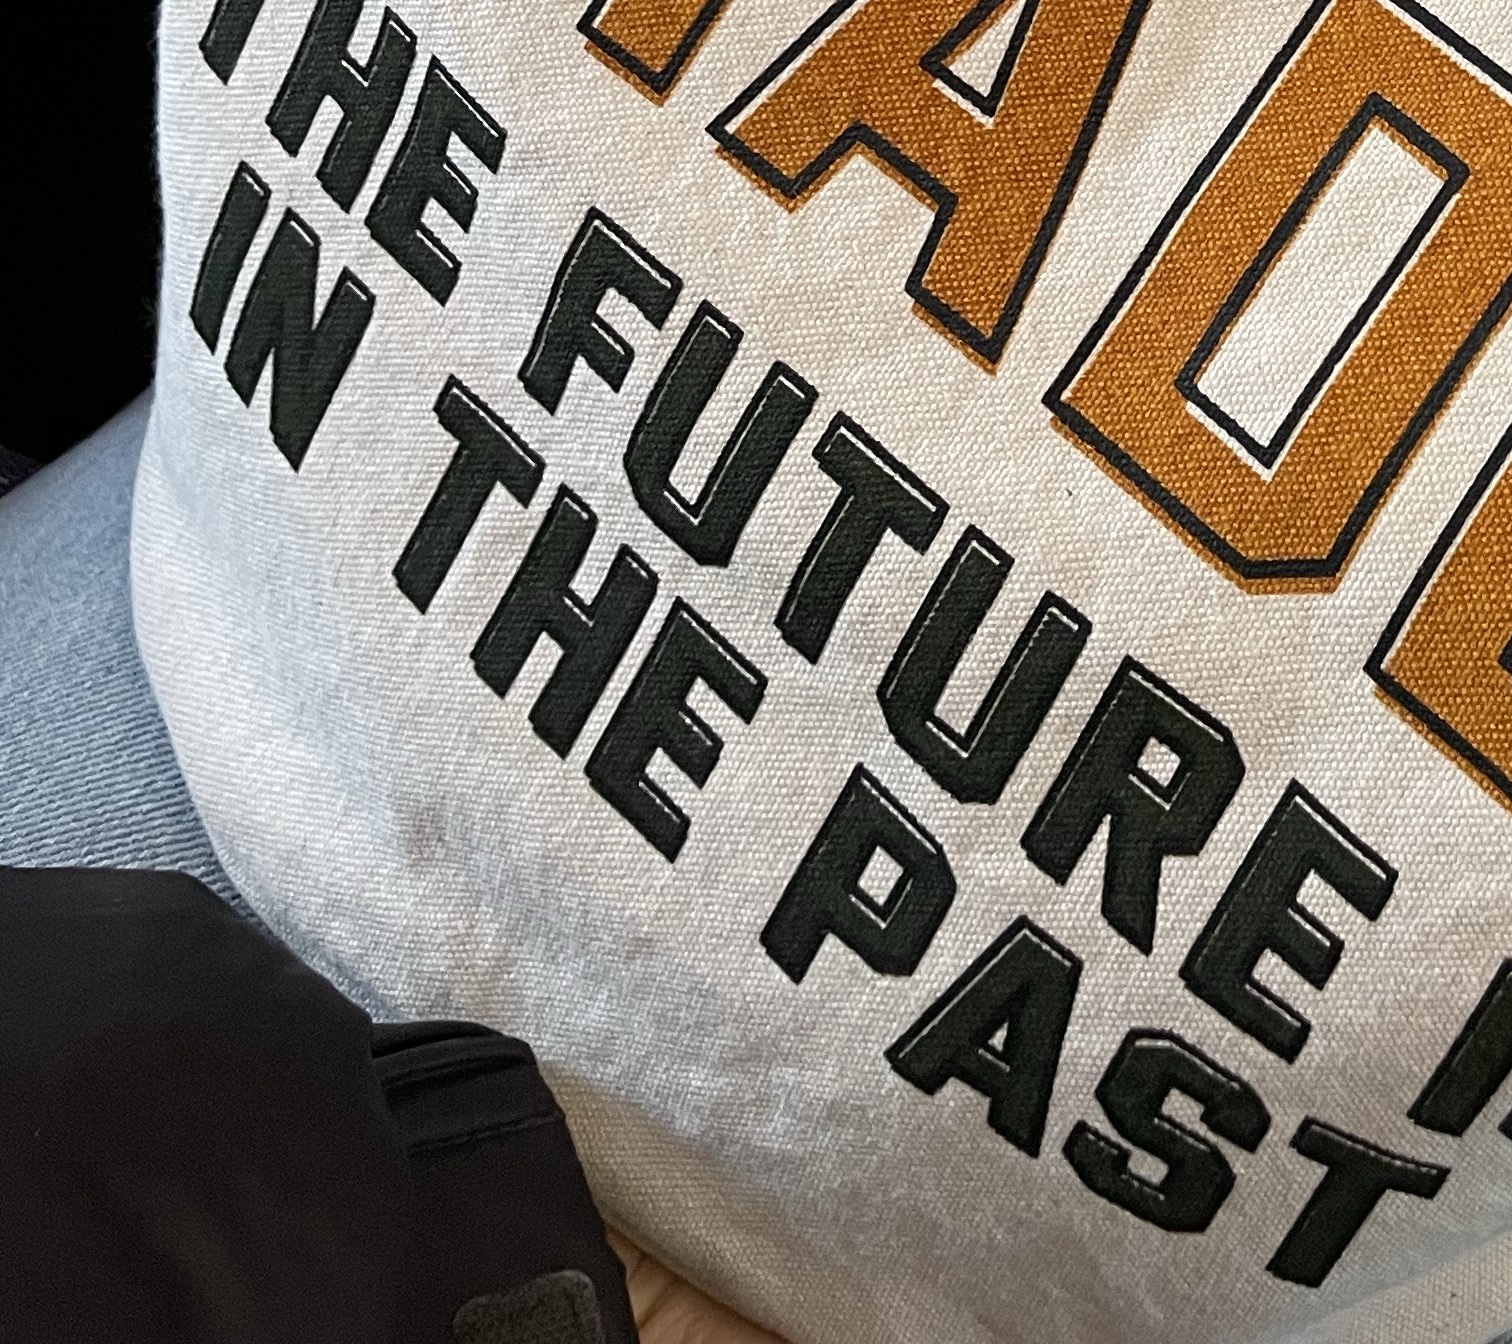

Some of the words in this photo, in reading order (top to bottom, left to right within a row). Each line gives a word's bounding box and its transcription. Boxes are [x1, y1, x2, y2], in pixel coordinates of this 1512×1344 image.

[189, 162, 376, 471] IN
[389, 375, 767, 863] THE
[759, 762, 1450, 1288] PAST
[518, 206, 1398, 1062] FUTURE
